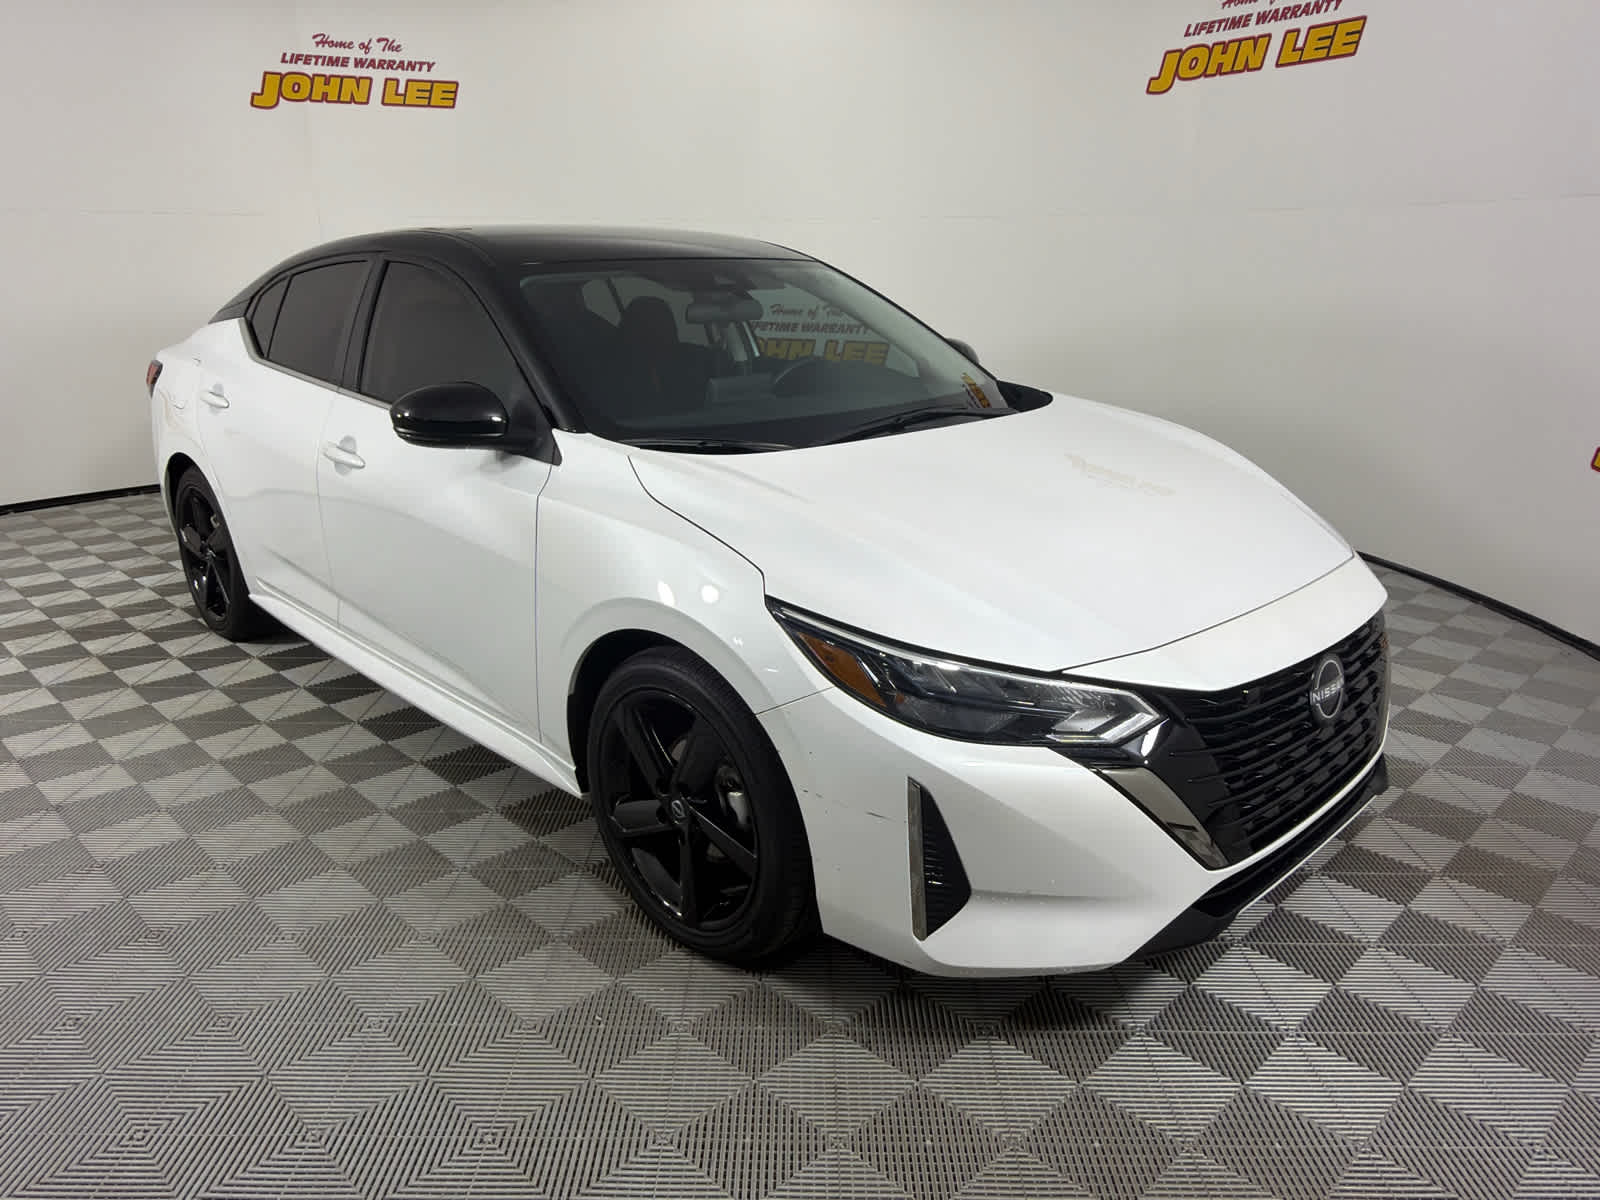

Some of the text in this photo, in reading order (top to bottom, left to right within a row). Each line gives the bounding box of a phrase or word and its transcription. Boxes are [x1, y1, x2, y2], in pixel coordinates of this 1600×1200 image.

[1184, 0, 1343, 37] LIFETIME WARRANTY
[312, 33, 402, 54] Home of The
[1146, 15, 1367, 95] JOHN LEE
[280, 52, 436, 73] LIFETIME WARRANTY
[250, 71, 459, 109] JOHN LEE
[824, 338, 890, 366] LEE
